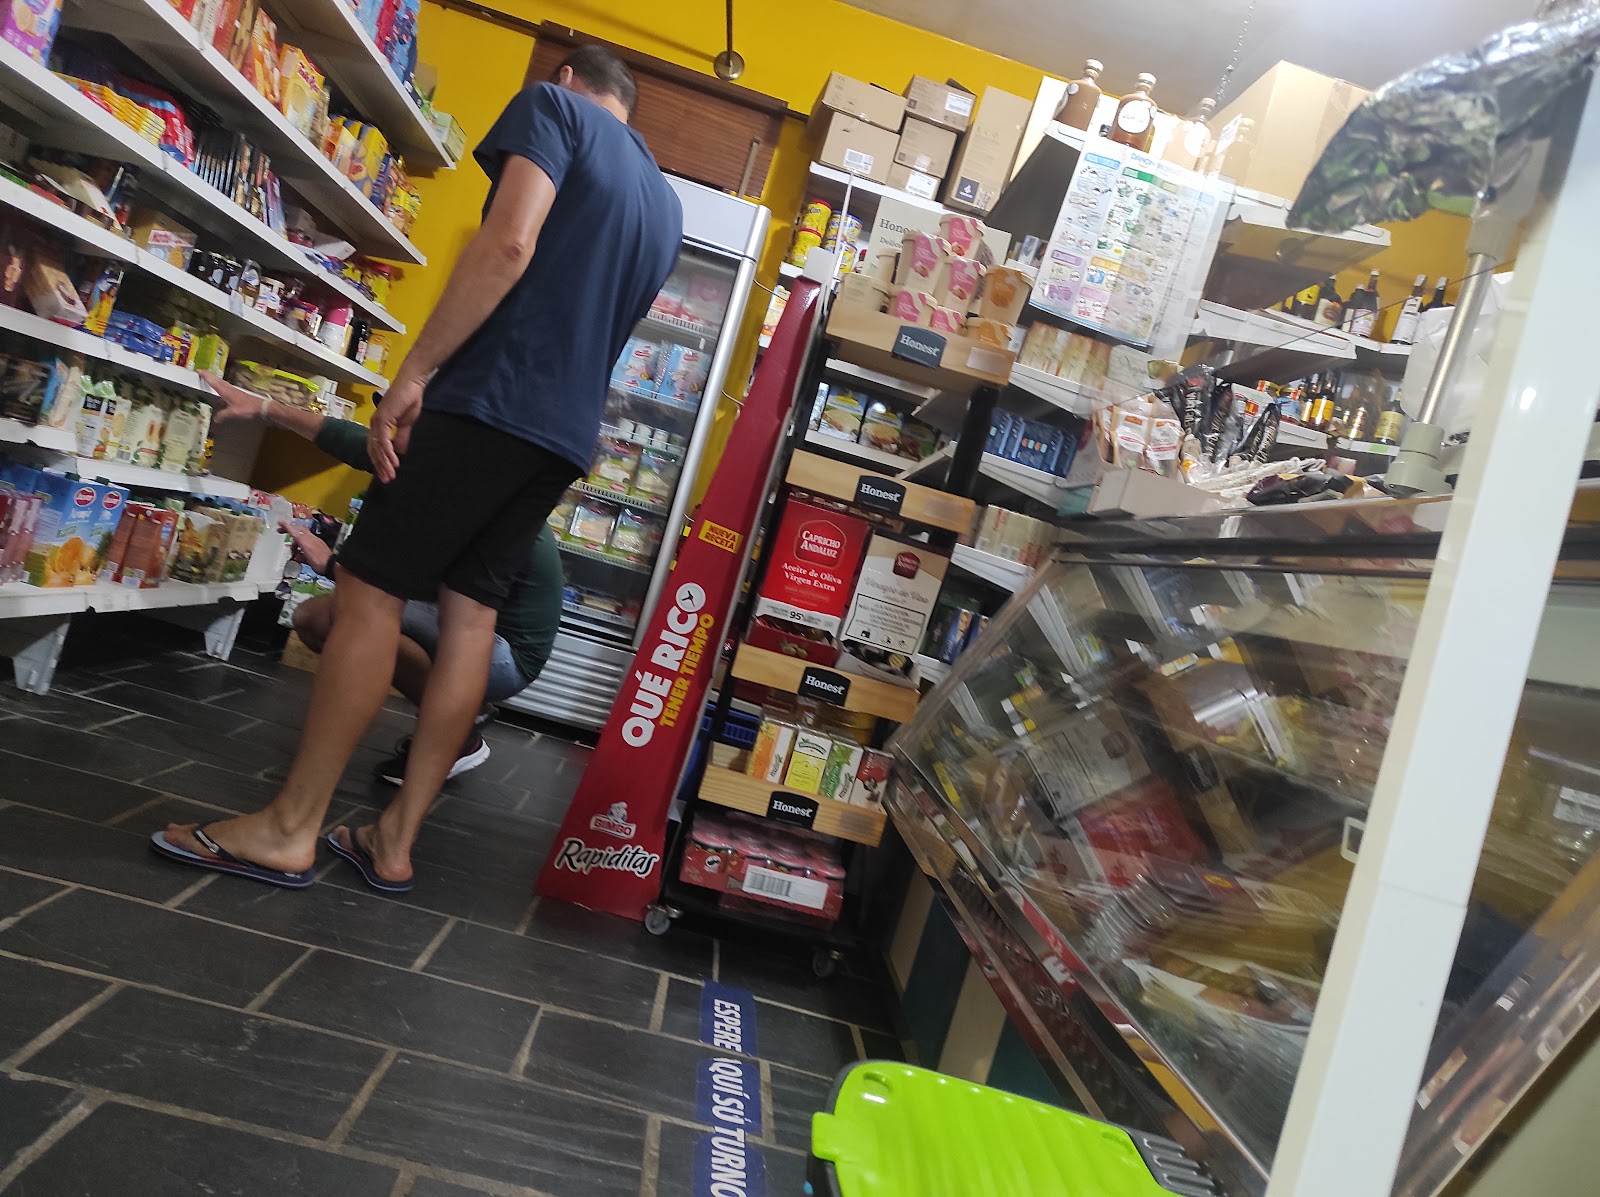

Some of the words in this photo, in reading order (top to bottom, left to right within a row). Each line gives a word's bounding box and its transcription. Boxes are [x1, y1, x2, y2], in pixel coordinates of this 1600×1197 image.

[900, 334, 940, 356] Honest
[860, 483, 901, 503] Honest
[704, 532, 734, 549] RECETA
[709, 525, 736, 542] NUEVA
[782, 562, 807, 575] Aceite
[808, 569, 818, 578] de
[820, 572, 842, 585] Oliva
[784, 571, 812, 586] Virgen
[812, 580, 836, 592] Extra
[622, 670, 672, 747] QUÉ
[651, 582, 706, 671] RICO
[659, 677, 691, 727] TENER
[679, 613, 715, 675] TIEMPO
[804, 674, 845, 696] Honest
[772, 799, 813, 818] Honest
[594, 818, 632, 836] BIMBO
[555, 838, 660, 878] Rapiditas
[713, 998, 742, 1053] ESPERE
[710, 1125, 746, 1197] TURNO
